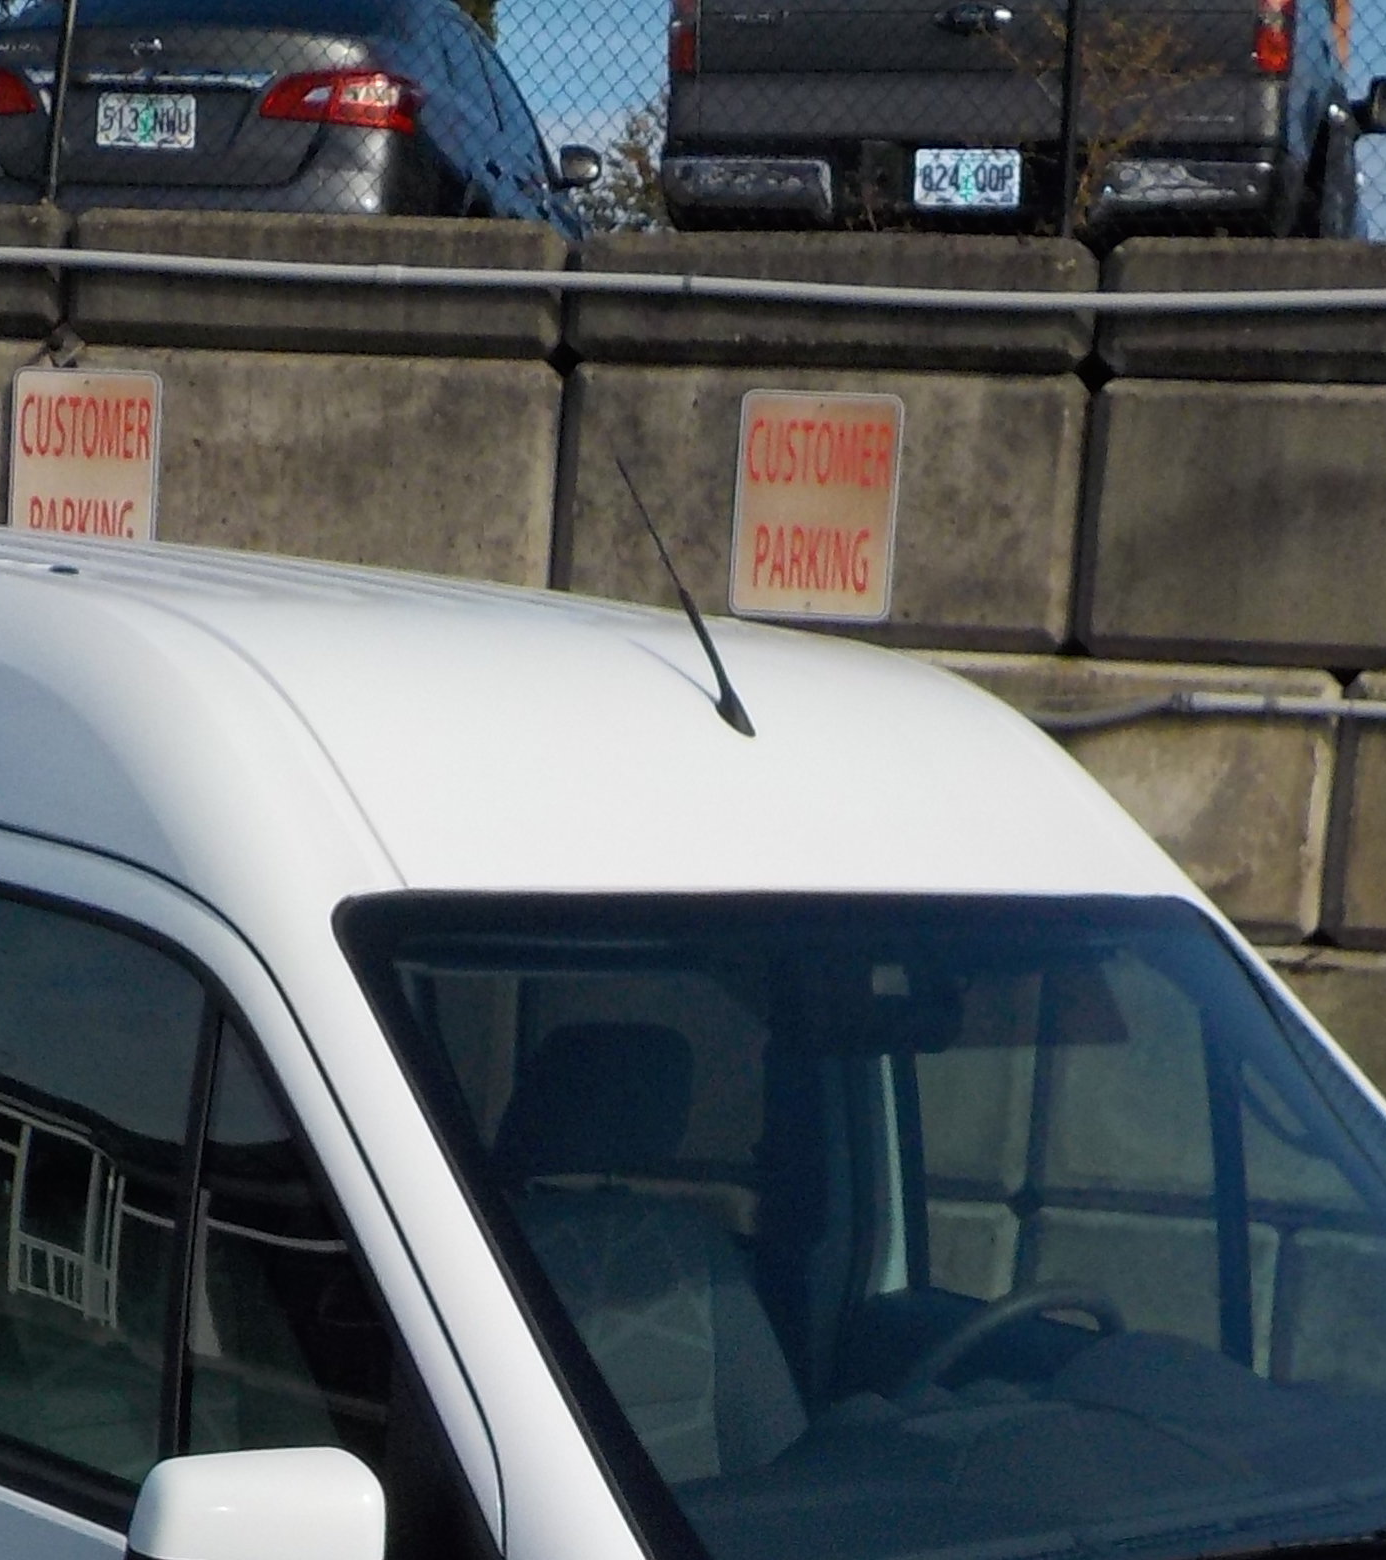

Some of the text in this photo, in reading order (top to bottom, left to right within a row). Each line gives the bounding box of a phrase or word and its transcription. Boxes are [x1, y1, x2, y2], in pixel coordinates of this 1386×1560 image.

[20, 394, 150, 460] CUSTOMER
[747, 417, 892, 489] CUSTOMER
[754, 523, 871, 594] PARKING
